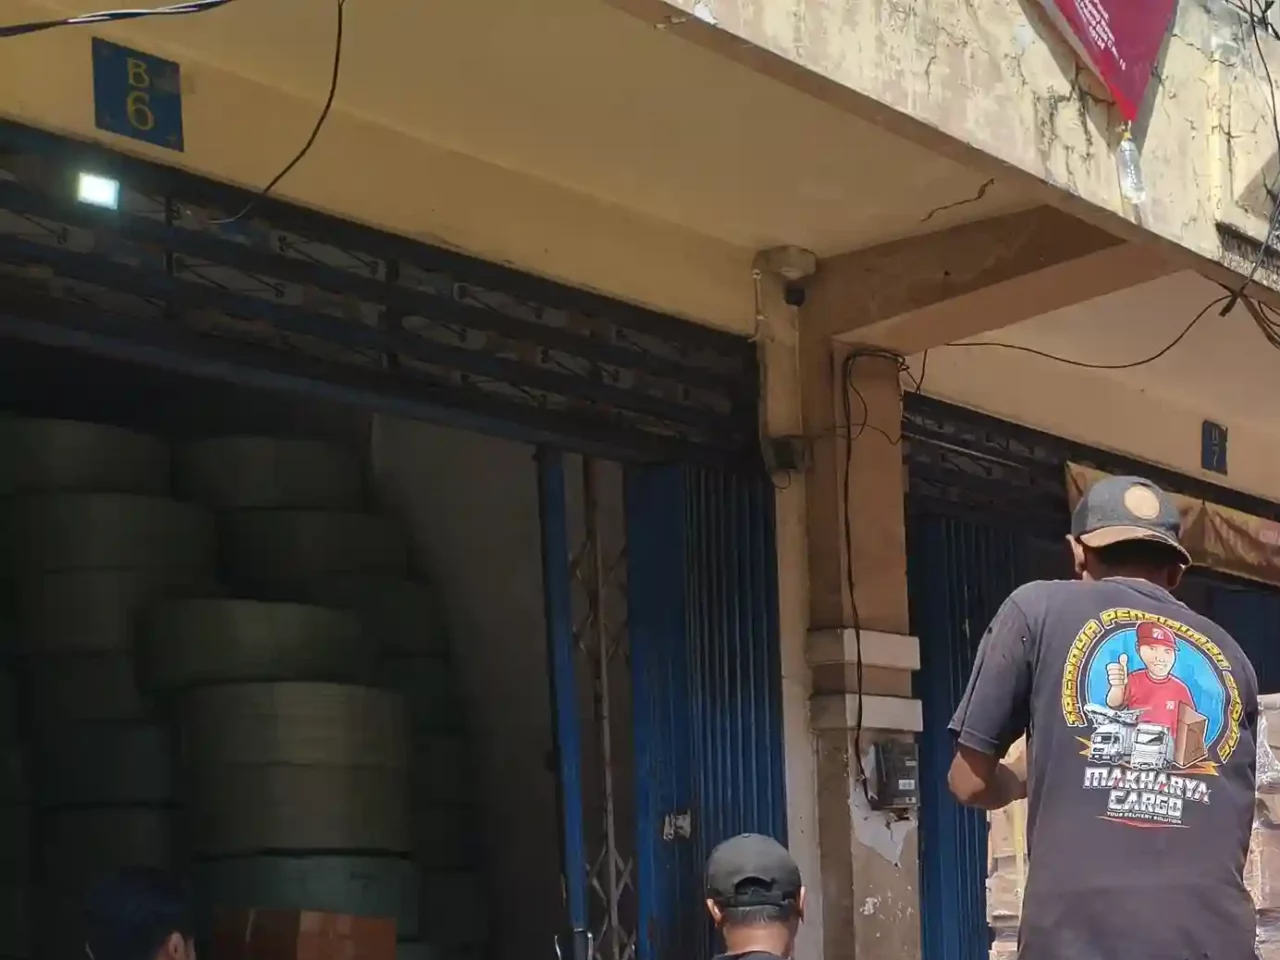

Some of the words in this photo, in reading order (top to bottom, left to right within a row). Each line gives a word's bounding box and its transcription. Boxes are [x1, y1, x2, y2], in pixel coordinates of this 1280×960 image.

[126, 57, 150, 88] B
[127, 91, 155, 130] 6
[1083, 766, 1211, 804] MAKHARYA
[1107, 789, 1183, 818] CARGO
